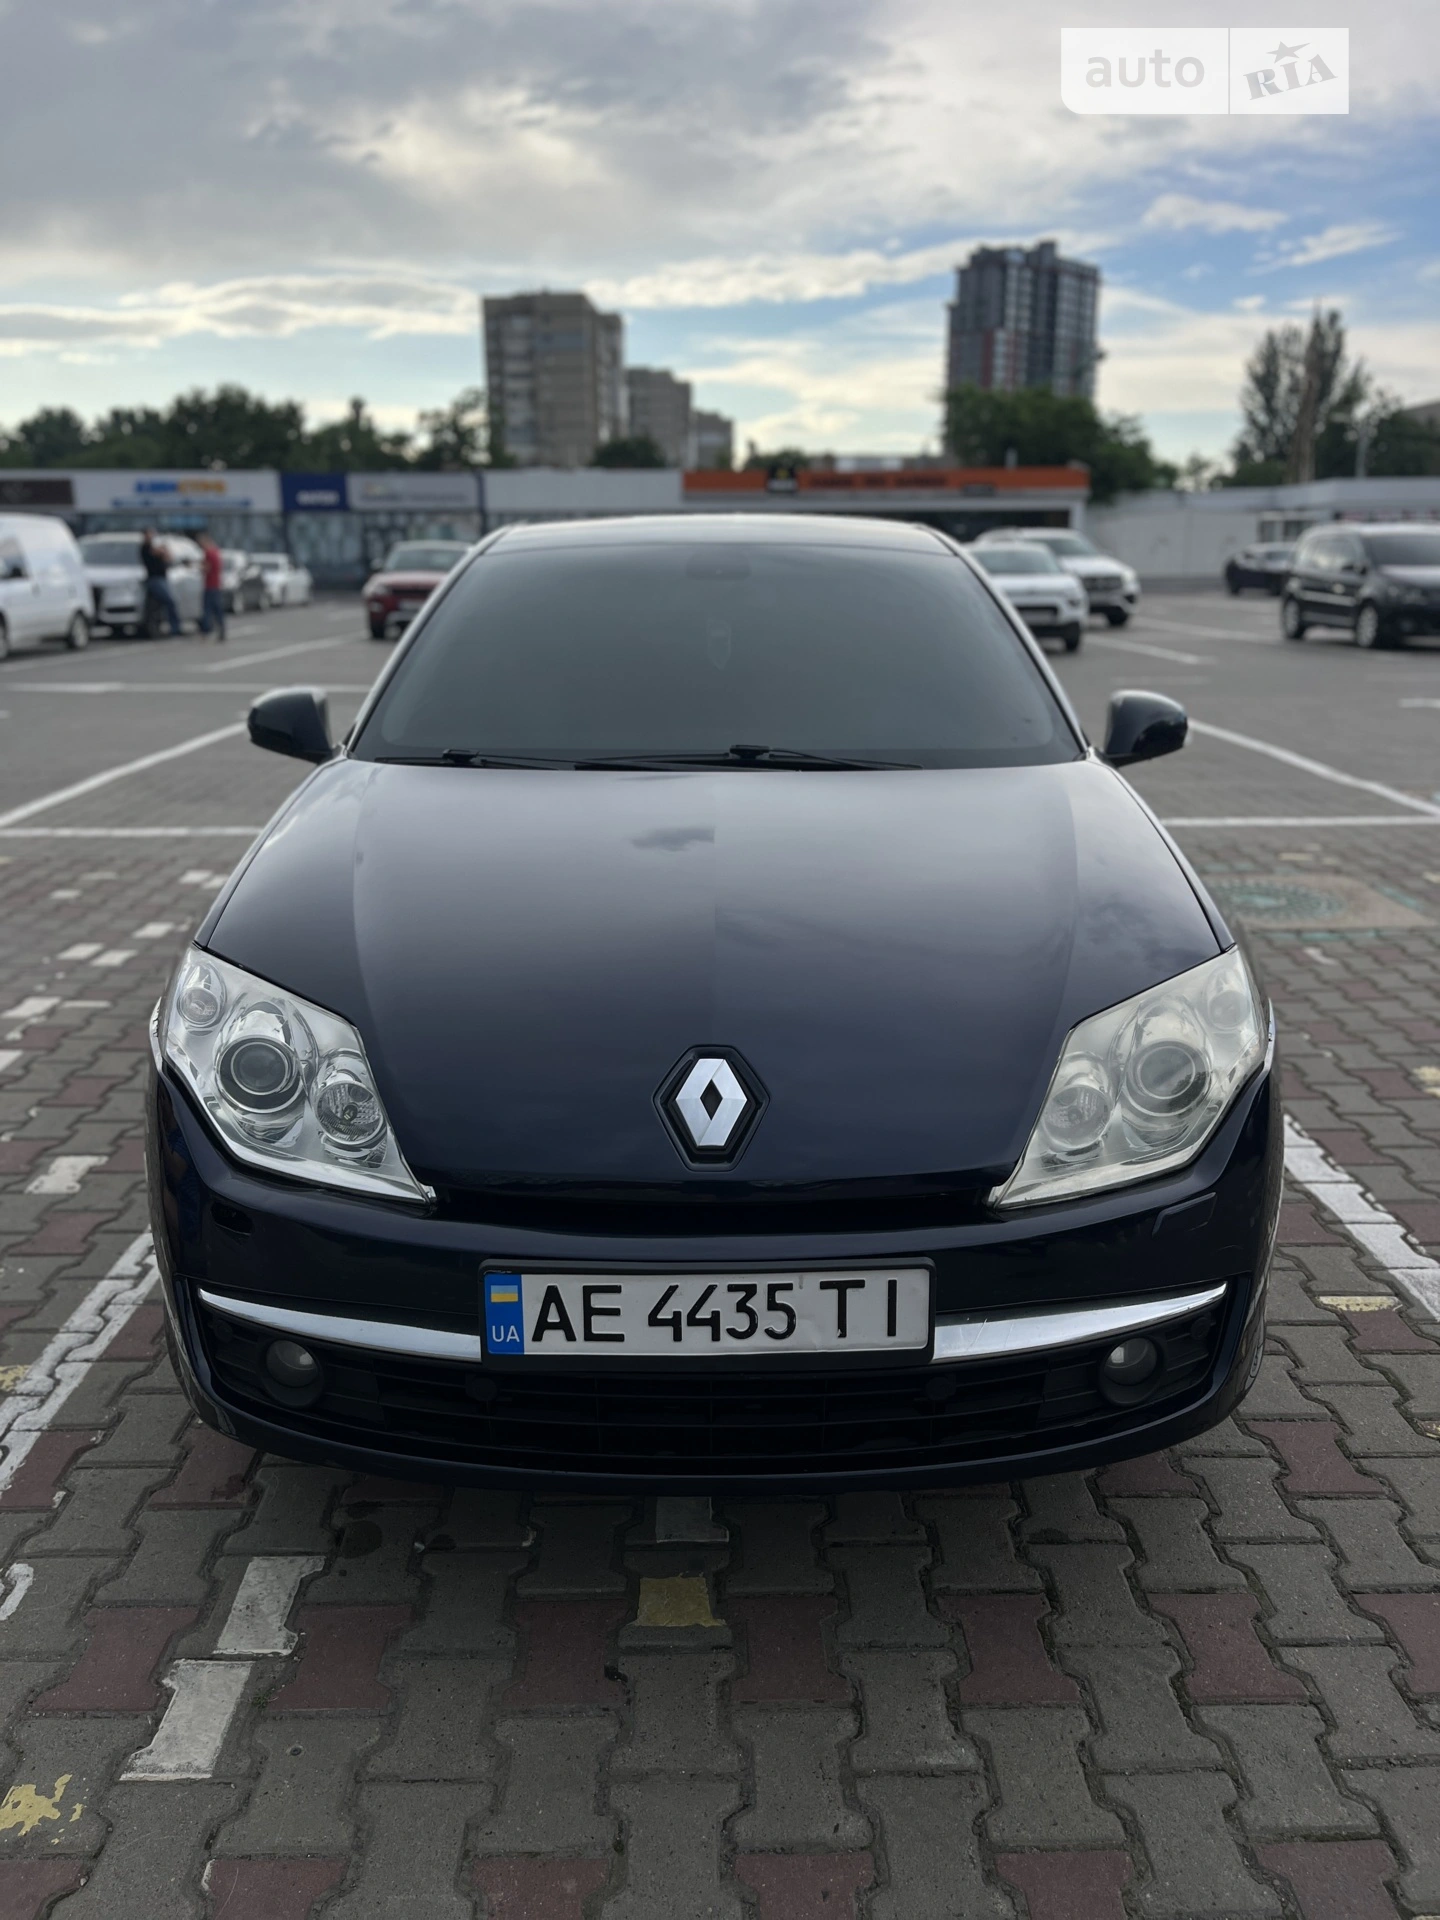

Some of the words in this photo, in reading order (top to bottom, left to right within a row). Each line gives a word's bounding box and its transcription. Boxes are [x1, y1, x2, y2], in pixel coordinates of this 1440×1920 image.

[531, 1284, 625, 1343] AE
[647, 1282, 797, 1343] 4435
[819, 1279, 898, 1338] TI
[491, 1324, 521, 1344] UA
